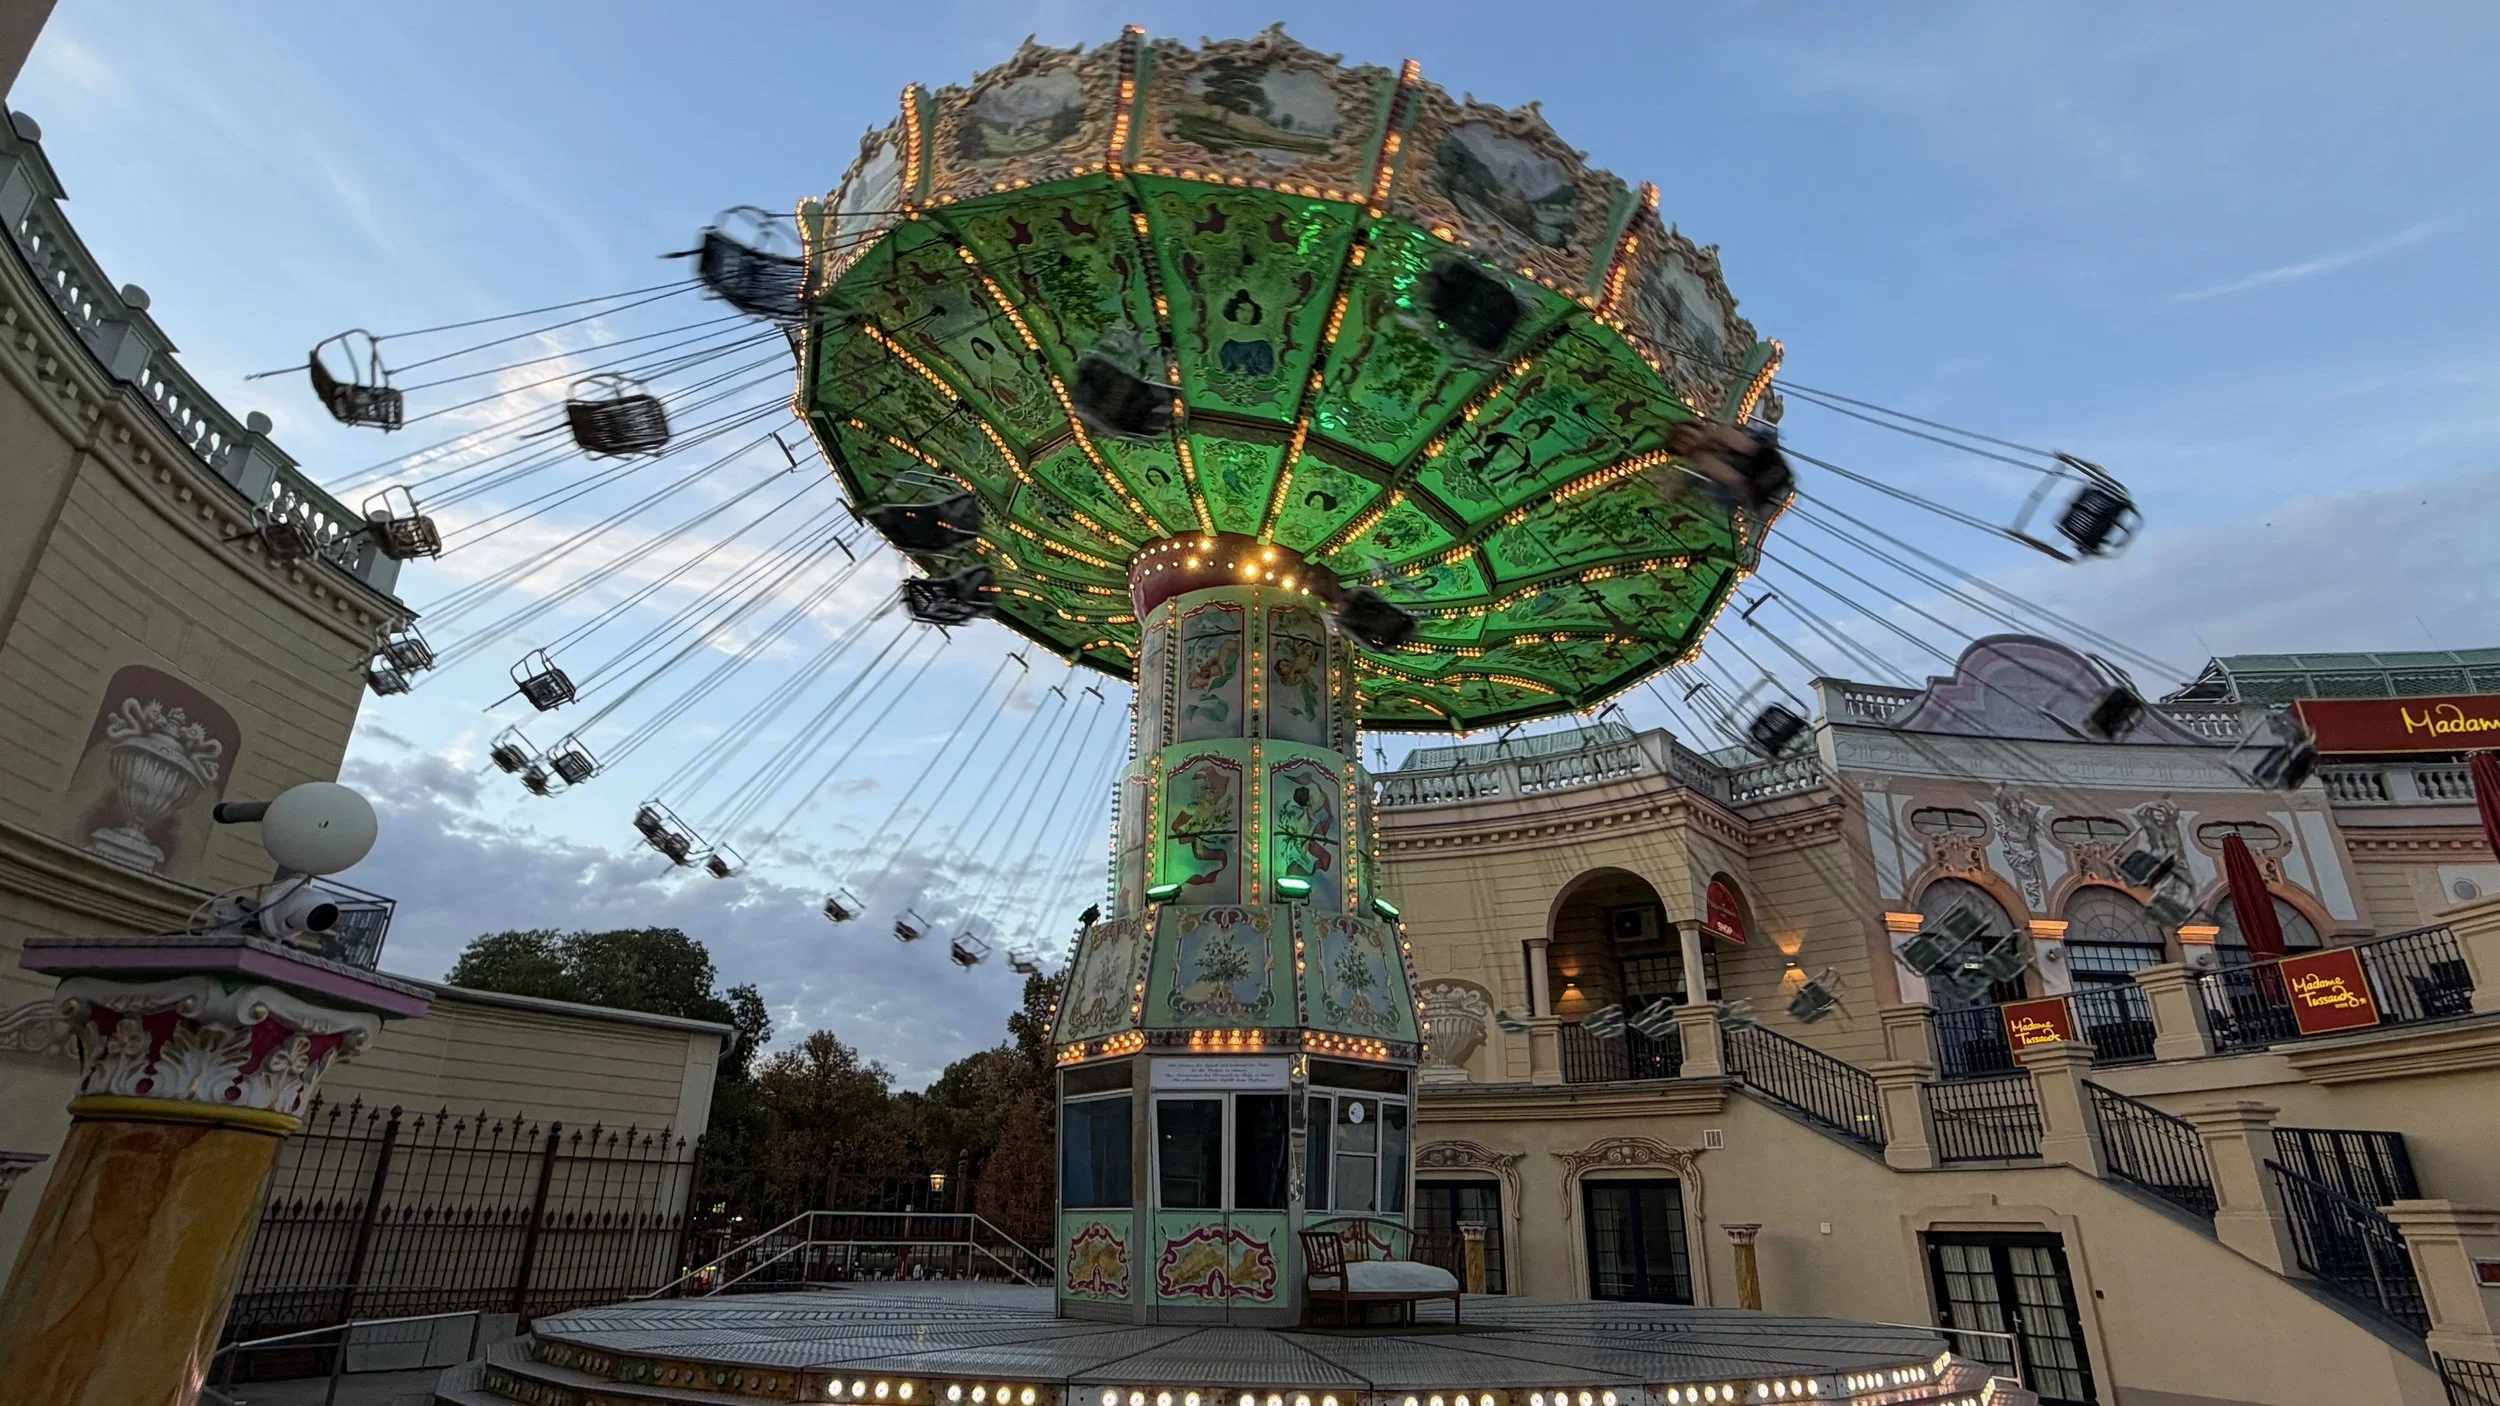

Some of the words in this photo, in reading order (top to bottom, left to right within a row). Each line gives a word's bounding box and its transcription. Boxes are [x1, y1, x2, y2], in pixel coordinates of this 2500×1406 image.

[2292, 973, 2344, 992] Madame
[2298, 985, 2359, 1007] Tussauds
[2010, 1017, 2053, 1032] Madame
